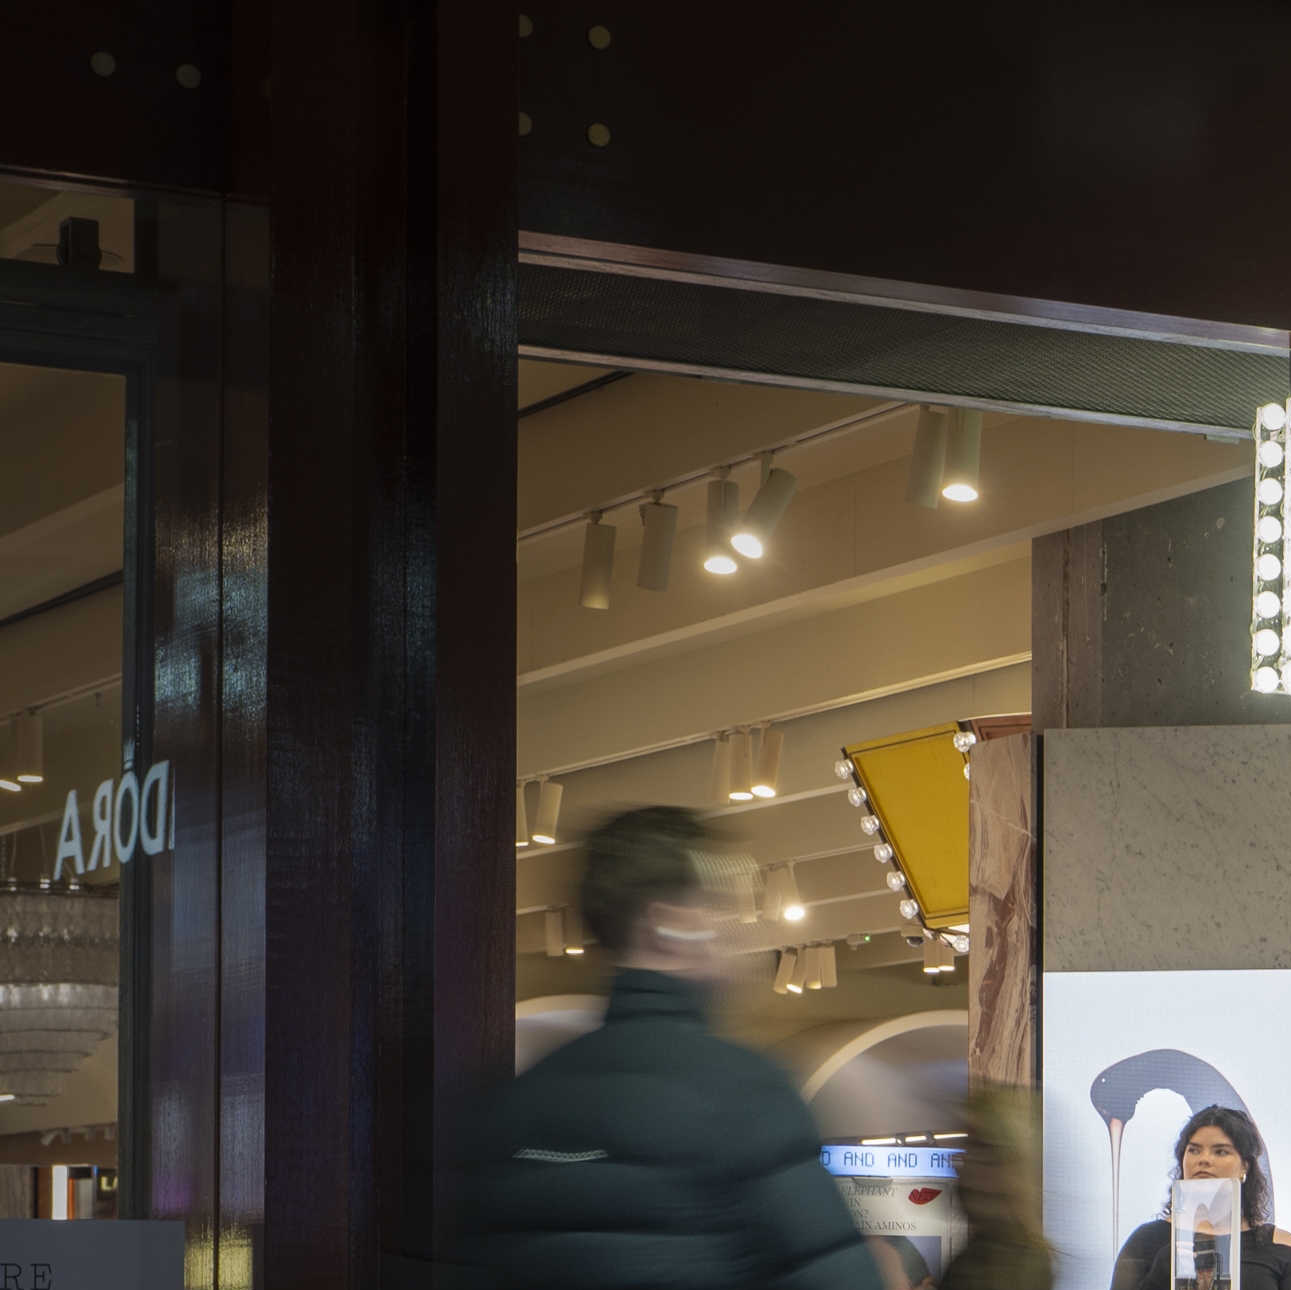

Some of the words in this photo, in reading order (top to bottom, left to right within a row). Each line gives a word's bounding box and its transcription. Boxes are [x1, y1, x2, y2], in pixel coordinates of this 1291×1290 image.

[844, 1151, 874, 1167] AND
[887, 1153, 918, 1168] AND
[875, 1221, 917, 1231] AMINOS
[0, 1263, 52, 1290] RE
